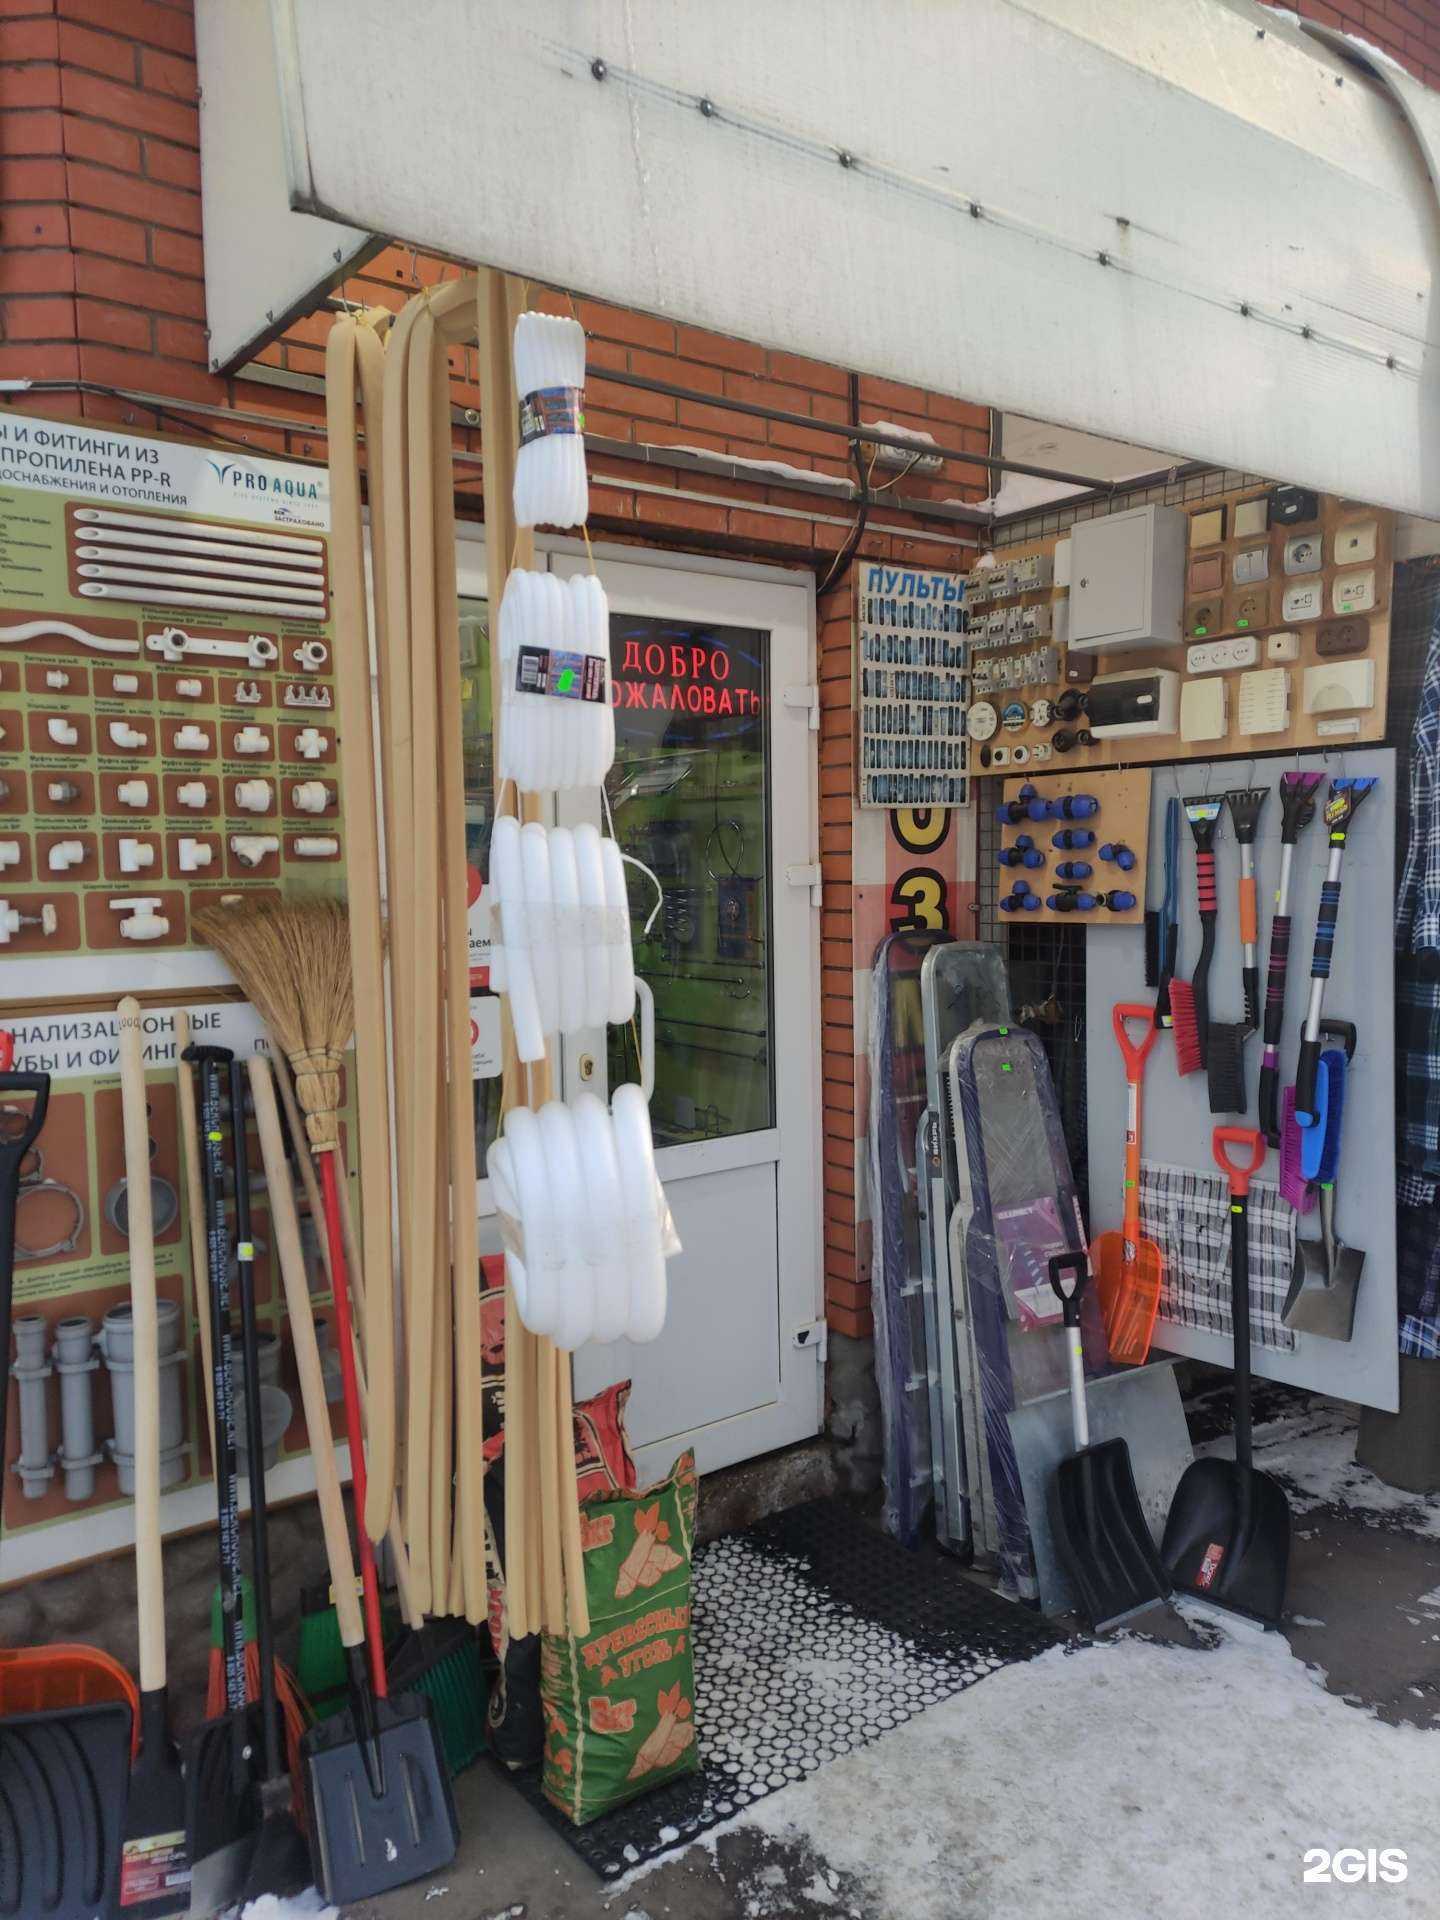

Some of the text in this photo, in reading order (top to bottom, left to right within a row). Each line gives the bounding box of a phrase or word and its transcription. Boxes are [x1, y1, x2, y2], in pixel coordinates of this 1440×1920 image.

[14, 425, 29, 443] И
[33, 430, 131, 461] ФИТИНГИ
[135, 446, 160, 465] ИЗ
[0, 467, 188, 506] ОСНАБЖЕНИЯ И ОТОПЛЕНИЯ
[1, 446, 171, 488] ПРОПИЛЕНА PP-R
[232, 470, 268, 492] PRO
[272, 477, 318, 500] AQUA
[867, 567, 966, 603] ПУЛЬТЫ
[622, 640, 730, 681] ДОБРО
[611, 679, 761, 716] ОЖАЛОВАТЬ
[65, 1051, 82, 1068] И
[581, 1605, 689, 1670] ДРЕВЕСНЫ
